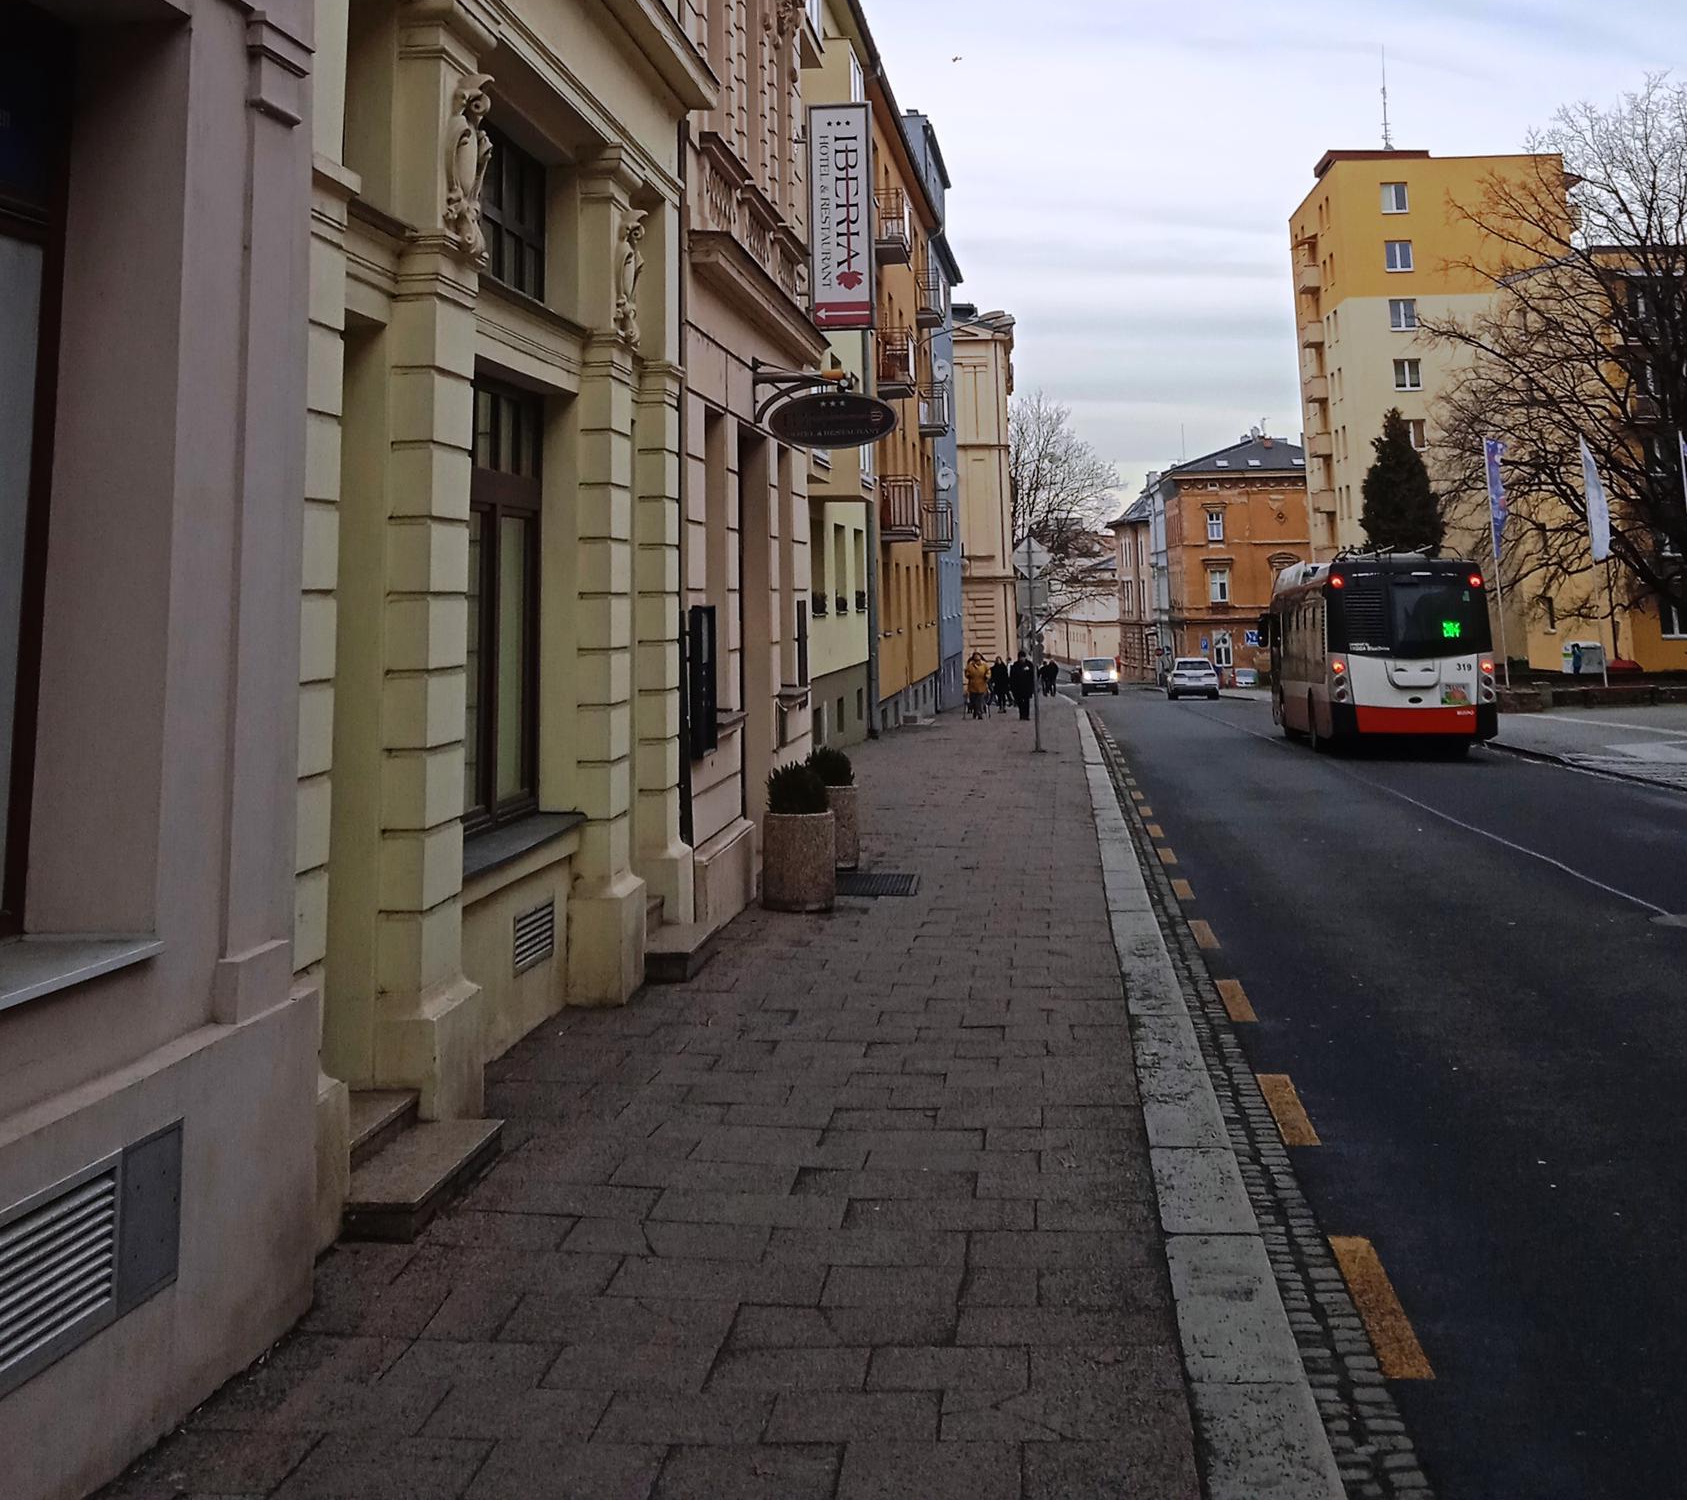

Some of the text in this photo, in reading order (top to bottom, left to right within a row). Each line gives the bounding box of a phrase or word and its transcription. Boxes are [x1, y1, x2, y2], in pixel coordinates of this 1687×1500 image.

[819, 135, 832, 289] HOTEL & RESTAURANT
[834, 135, 861, 269] IBERIA
[1456, 662, 1472, 671] 319
